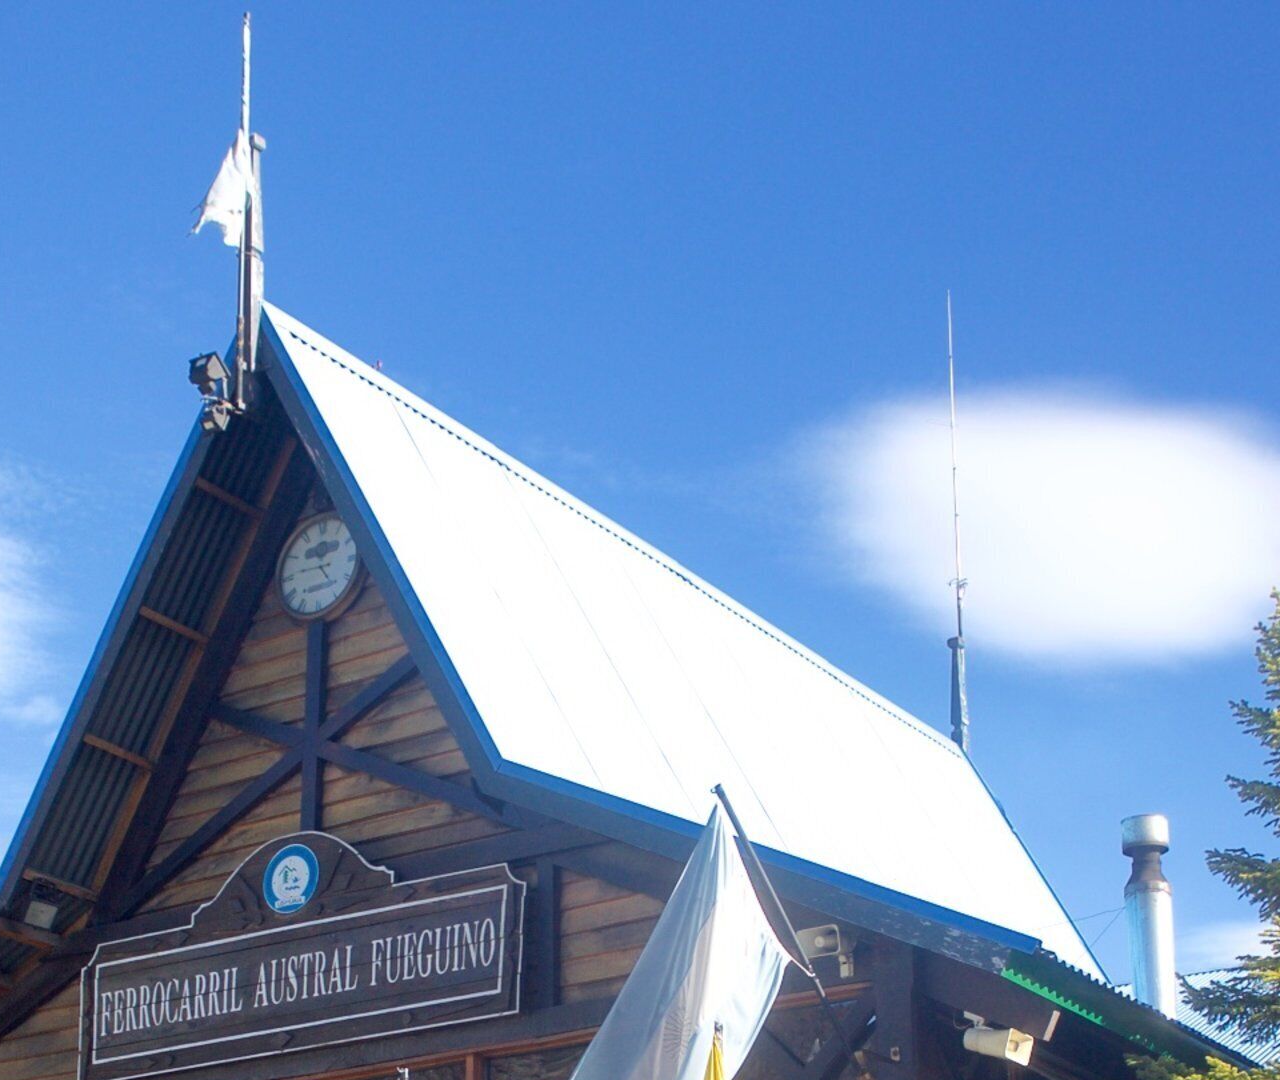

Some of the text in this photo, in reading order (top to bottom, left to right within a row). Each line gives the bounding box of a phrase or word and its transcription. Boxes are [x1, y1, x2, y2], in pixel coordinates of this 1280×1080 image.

[99, 917, 497, 1036] FERROCARRIL AUSTRAL FUEGUINO
